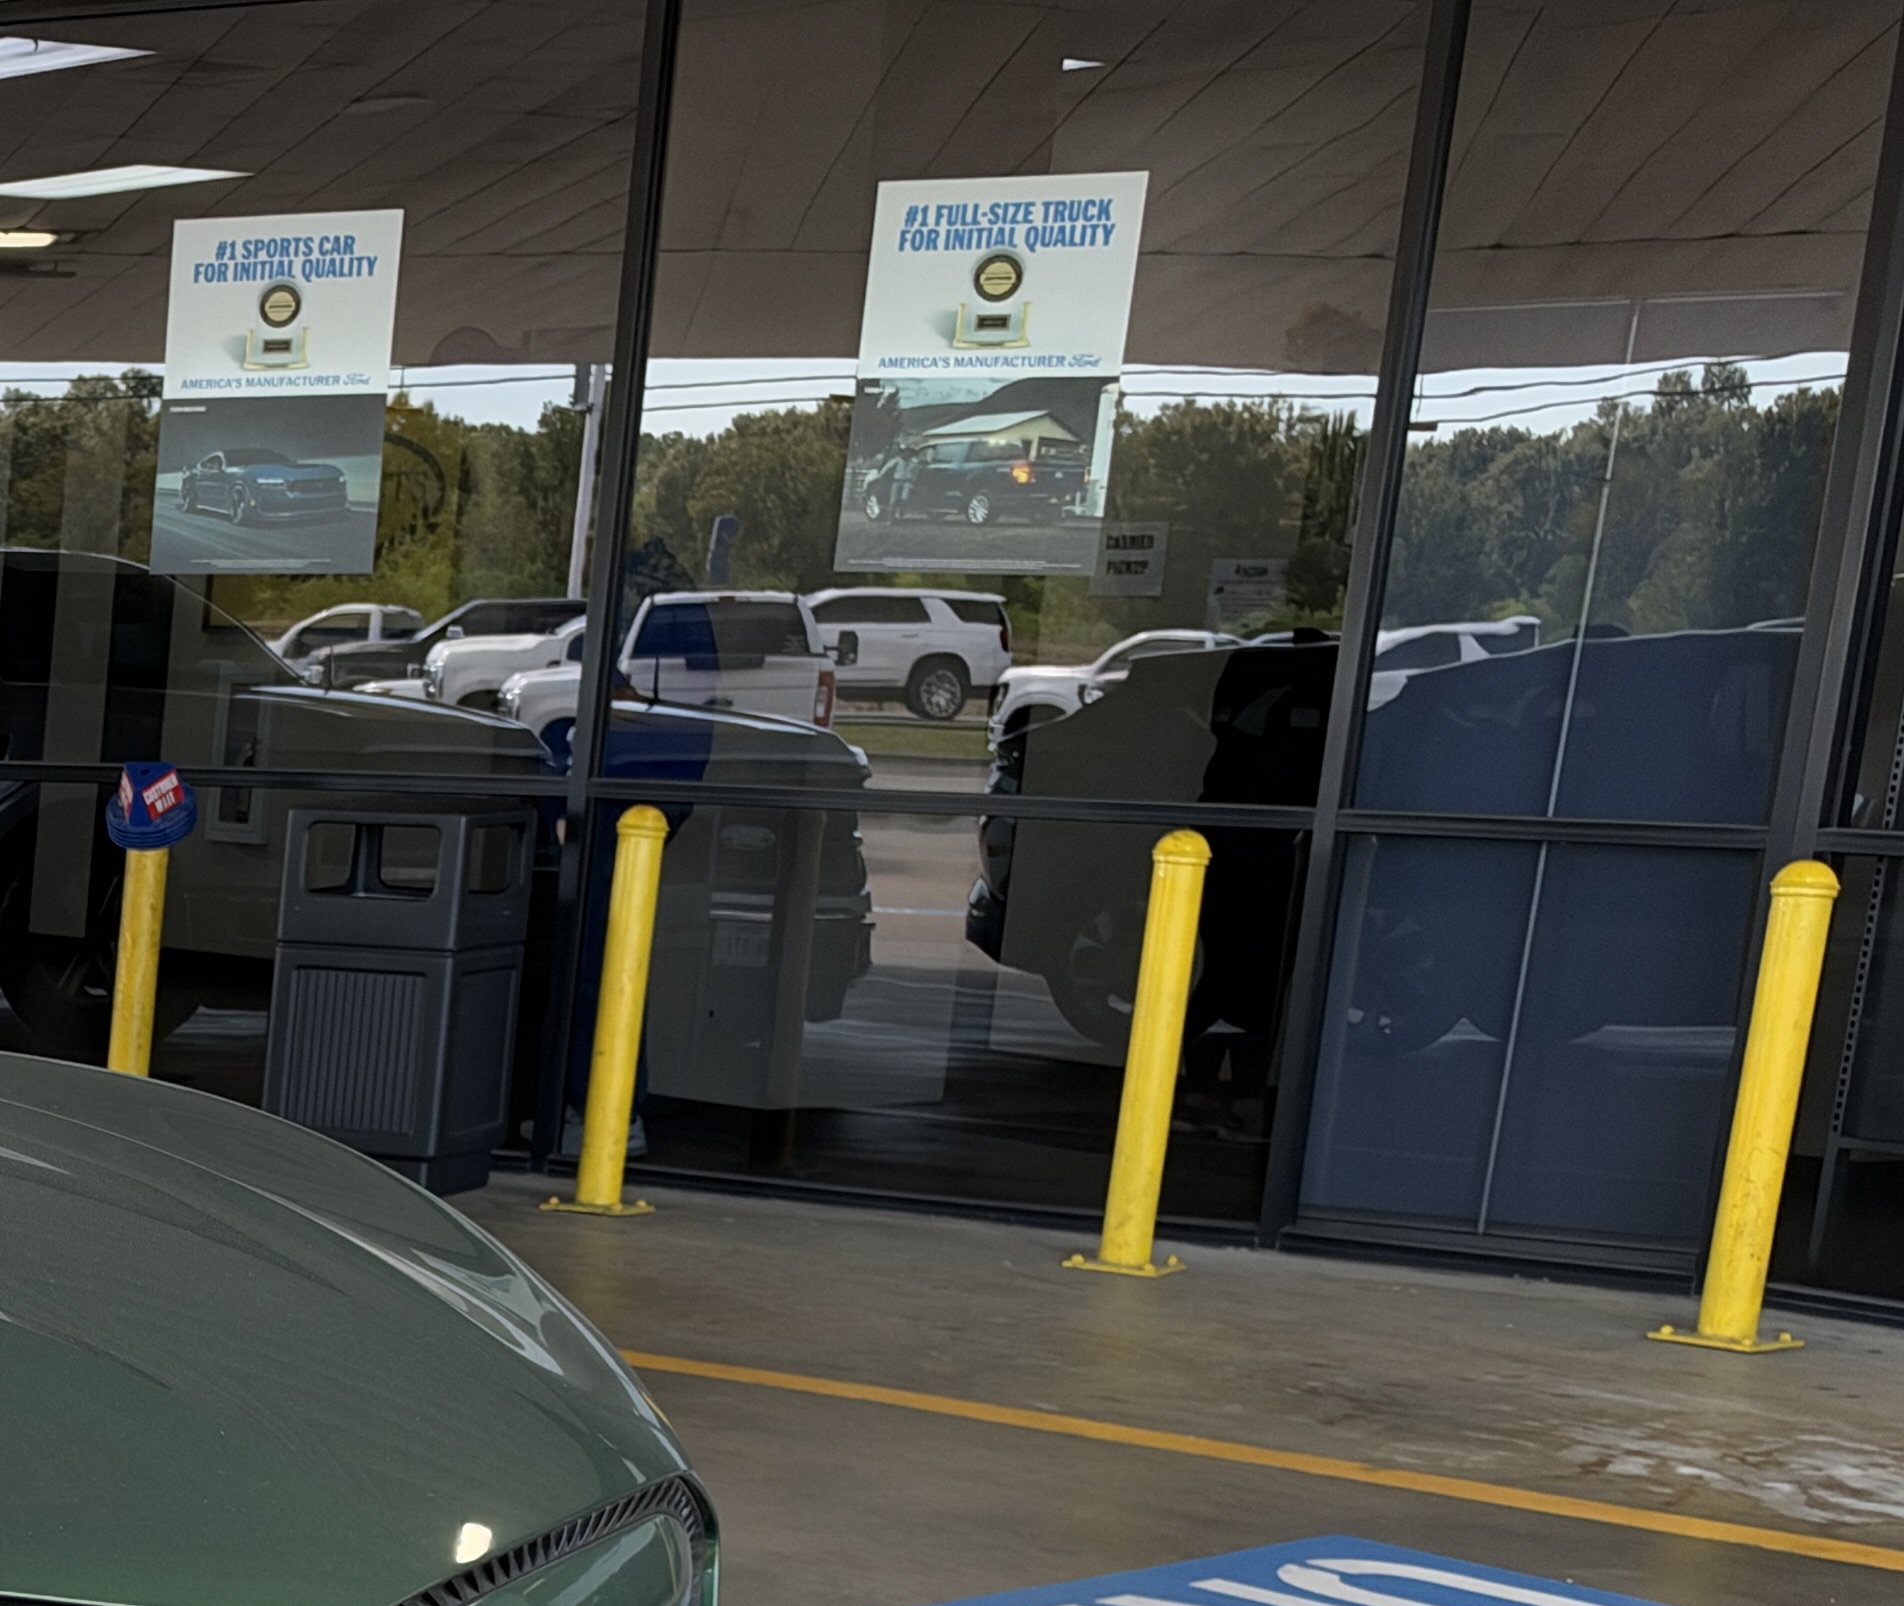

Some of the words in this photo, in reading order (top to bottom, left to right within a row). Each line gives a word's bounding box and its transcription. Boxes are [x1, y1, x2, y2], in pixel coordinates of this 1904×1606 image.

[904, 205, 930, 228] #1
[934, 202, 1036, 227] FULL-SIZE
[1042, 199, 1113, 223] TRUCK
[215, 240, 237, 261] #1
[241, 237, 314, 260] SPORTS
[318, 235, 356, 257] CAR
[898, 229, 940, 251] FOR
[944, 226, 1018, 250] INITIAL
[1025, 224, 1116, 253] QUALITY
[193, 263, 229, 283] FOR
[233, 260, 296, 282] INITIAL
[301, 256, 378, 282] QUALITY
[877, 355, 951, 369] AMERICA'S
[953, 355, 1066, 369] MANUFACTURER
[180, 377, 243, 390] AMERICA'S
[245, 375, 341, 388] MANUFACTURER
